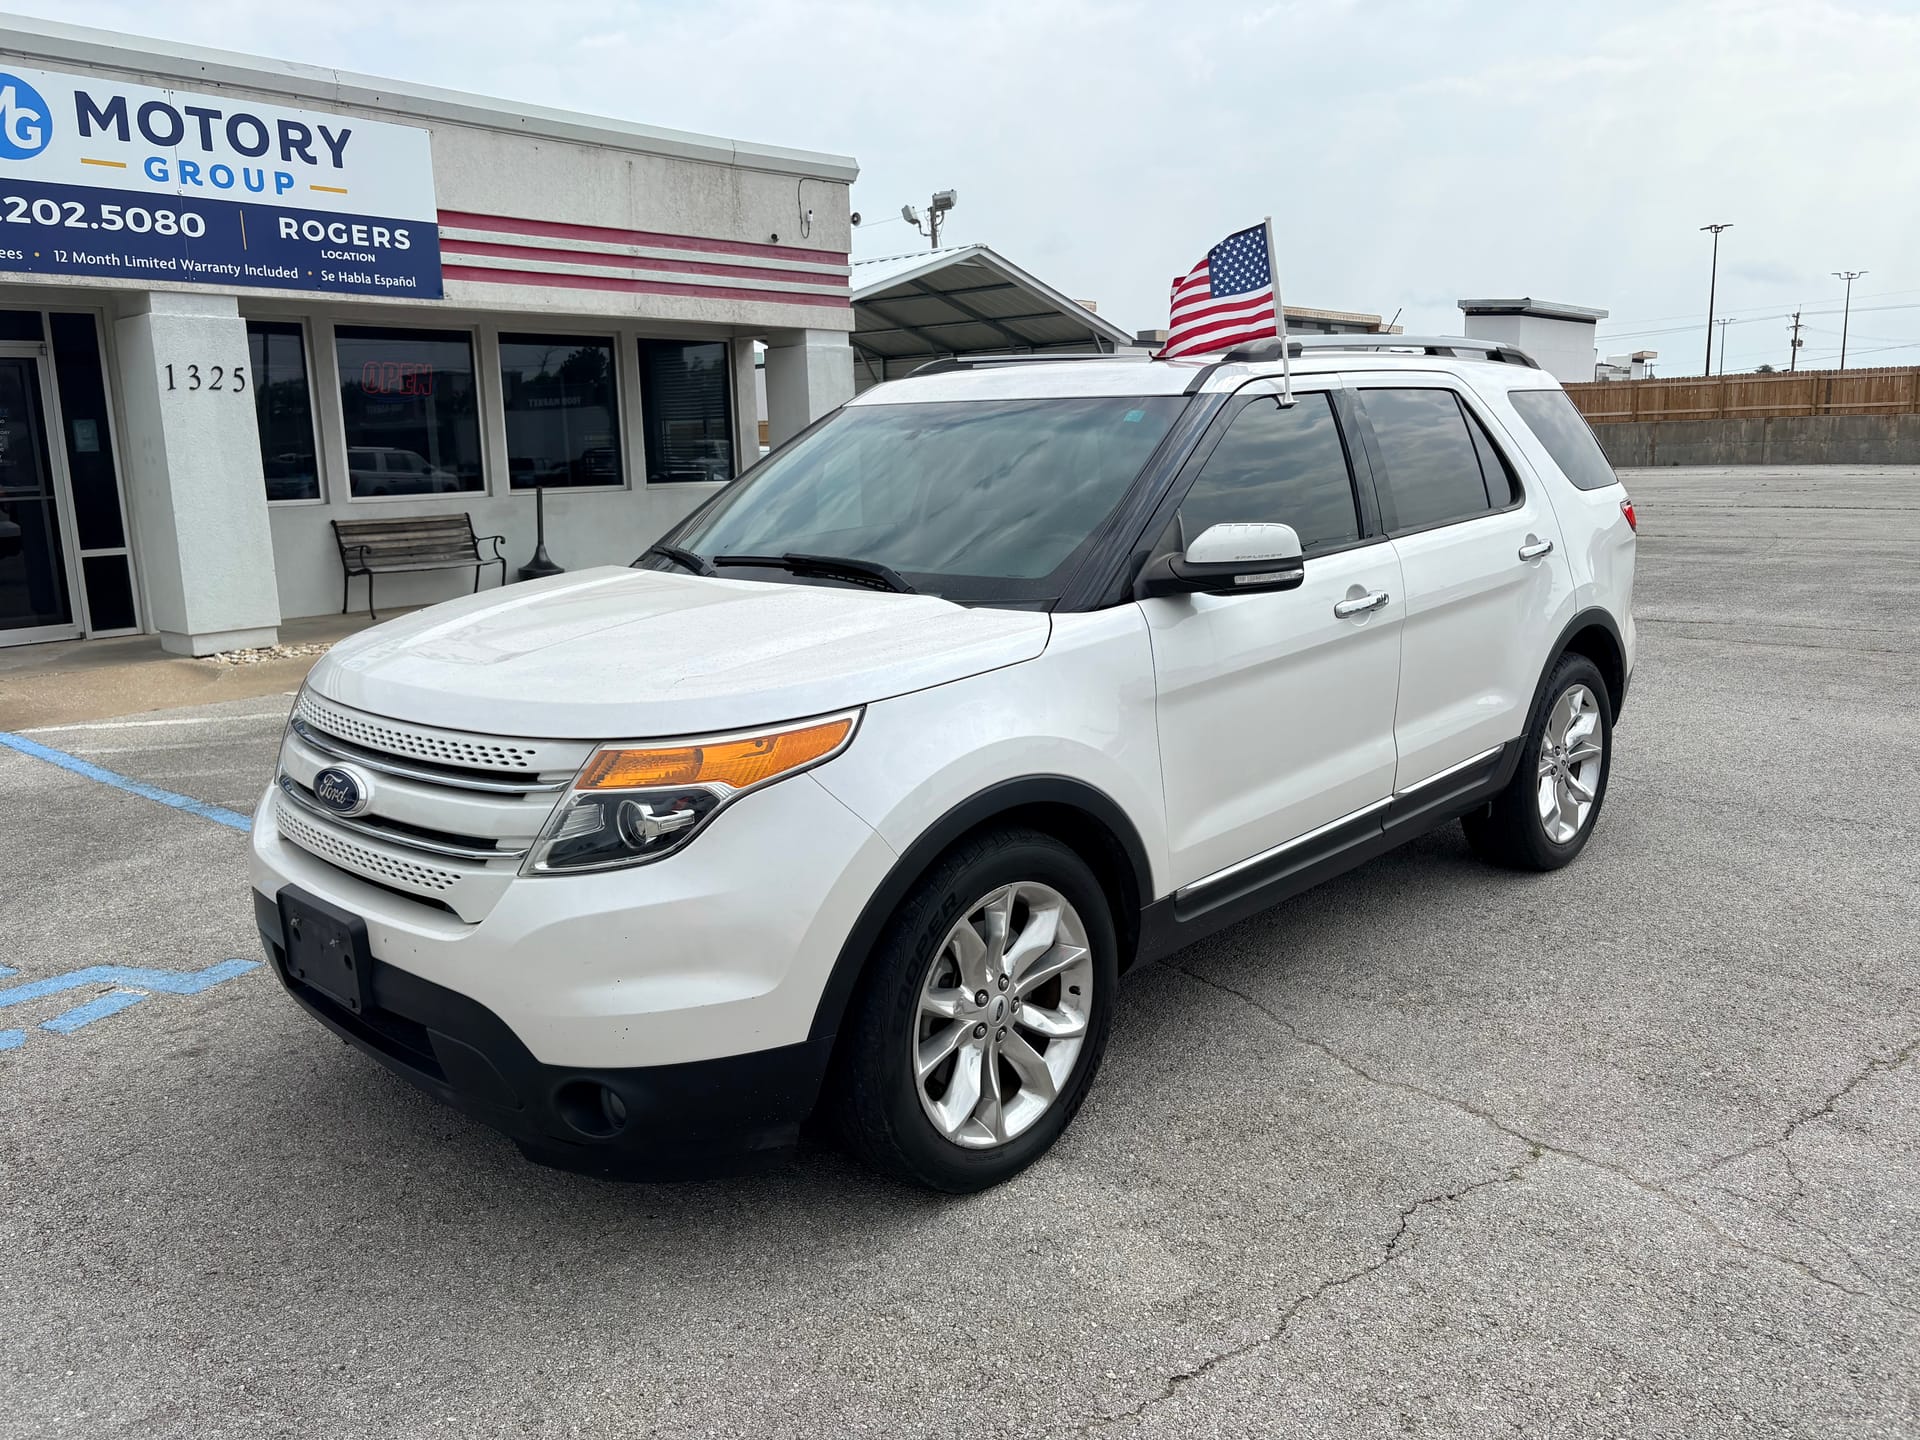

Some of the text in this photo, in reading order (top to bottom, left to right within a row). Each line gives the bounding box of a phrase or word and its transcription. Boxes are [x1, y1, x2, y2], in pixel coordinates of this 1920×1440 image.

[74, 90, 352, 169] MOTORY
[143, 156, 295, 195] GROUP
[279, 216, 411, 250] ROGERS
[54, 250, 68, 263] 12
[73, 251, 121, 266] Month
[124, 255, 177, 270] Limited
[180, 258, 241, 277] Warranty
[245, 263, 299, 279] Included
[321, 270, 335, 282] Se
[338, 271, 371, 284] Habla
[375, 274, 417, 288] Español
[321, 250, 376, 263] LOCATION
[164, 363, 246, 393] 1325
[361, 361, 433, 395] OPEN
[319, 773, 349, 804] Ford
